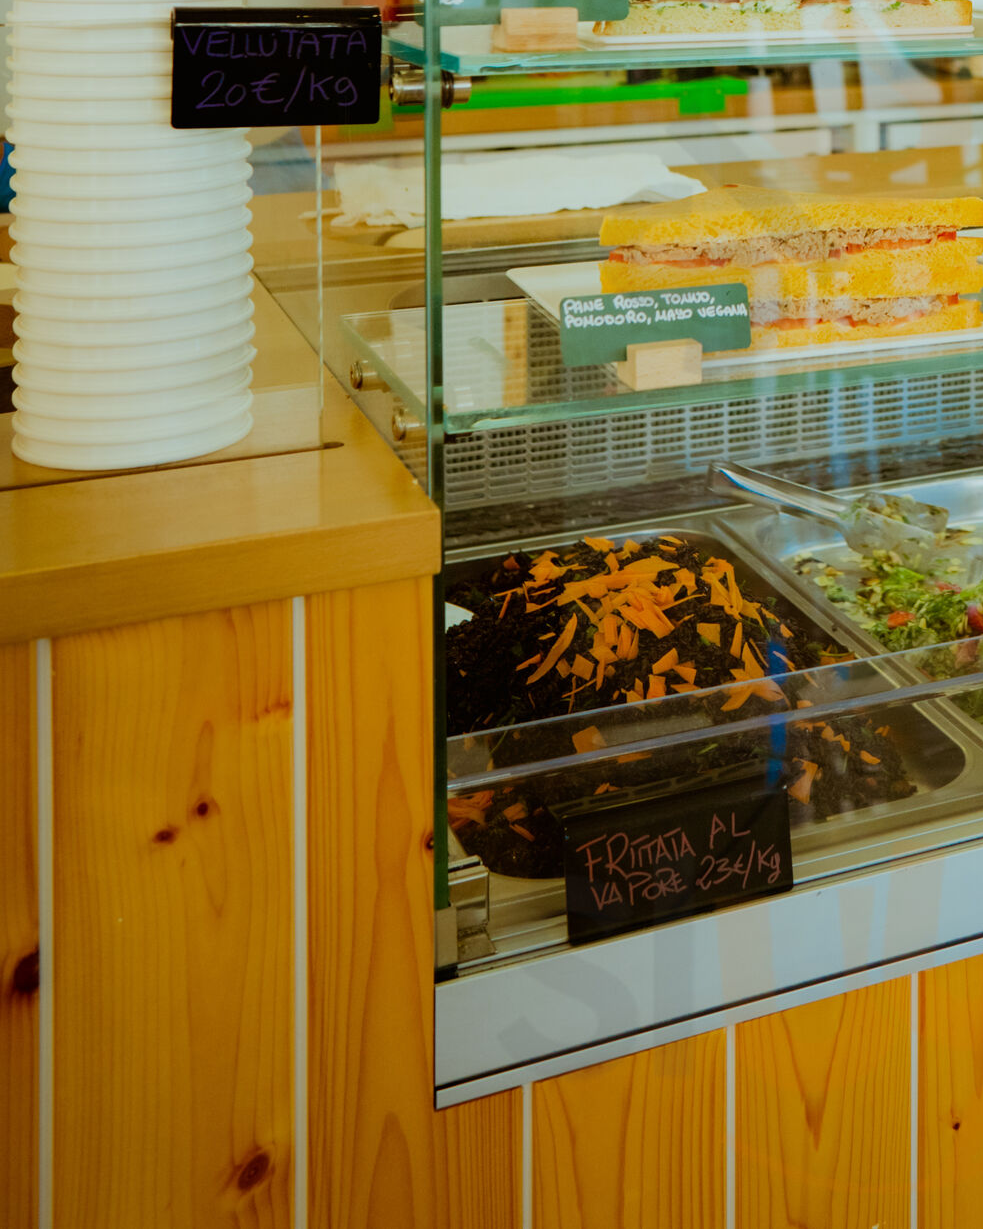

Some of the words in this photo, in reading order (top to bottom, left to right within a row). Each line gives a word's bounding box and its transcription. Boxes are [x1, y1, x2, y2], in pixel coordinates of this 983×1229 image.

[180, 27, 368, 60] VELLUTATA
[563, 298, 605, 315] PANE
[613, 294, 659, 310] ROSSO,
[661, 291, 715, 305] TONNO,
[564, 309, 651, 329] POMODORO,
[655, 308, 693, 322] MAYO
[698, 303, 748, 318] VEGANA
[576, 827, 697, 883] FRITTATA
[709, 812, 752, 850] AL
[590, 867, 689, 911] VAPORE
